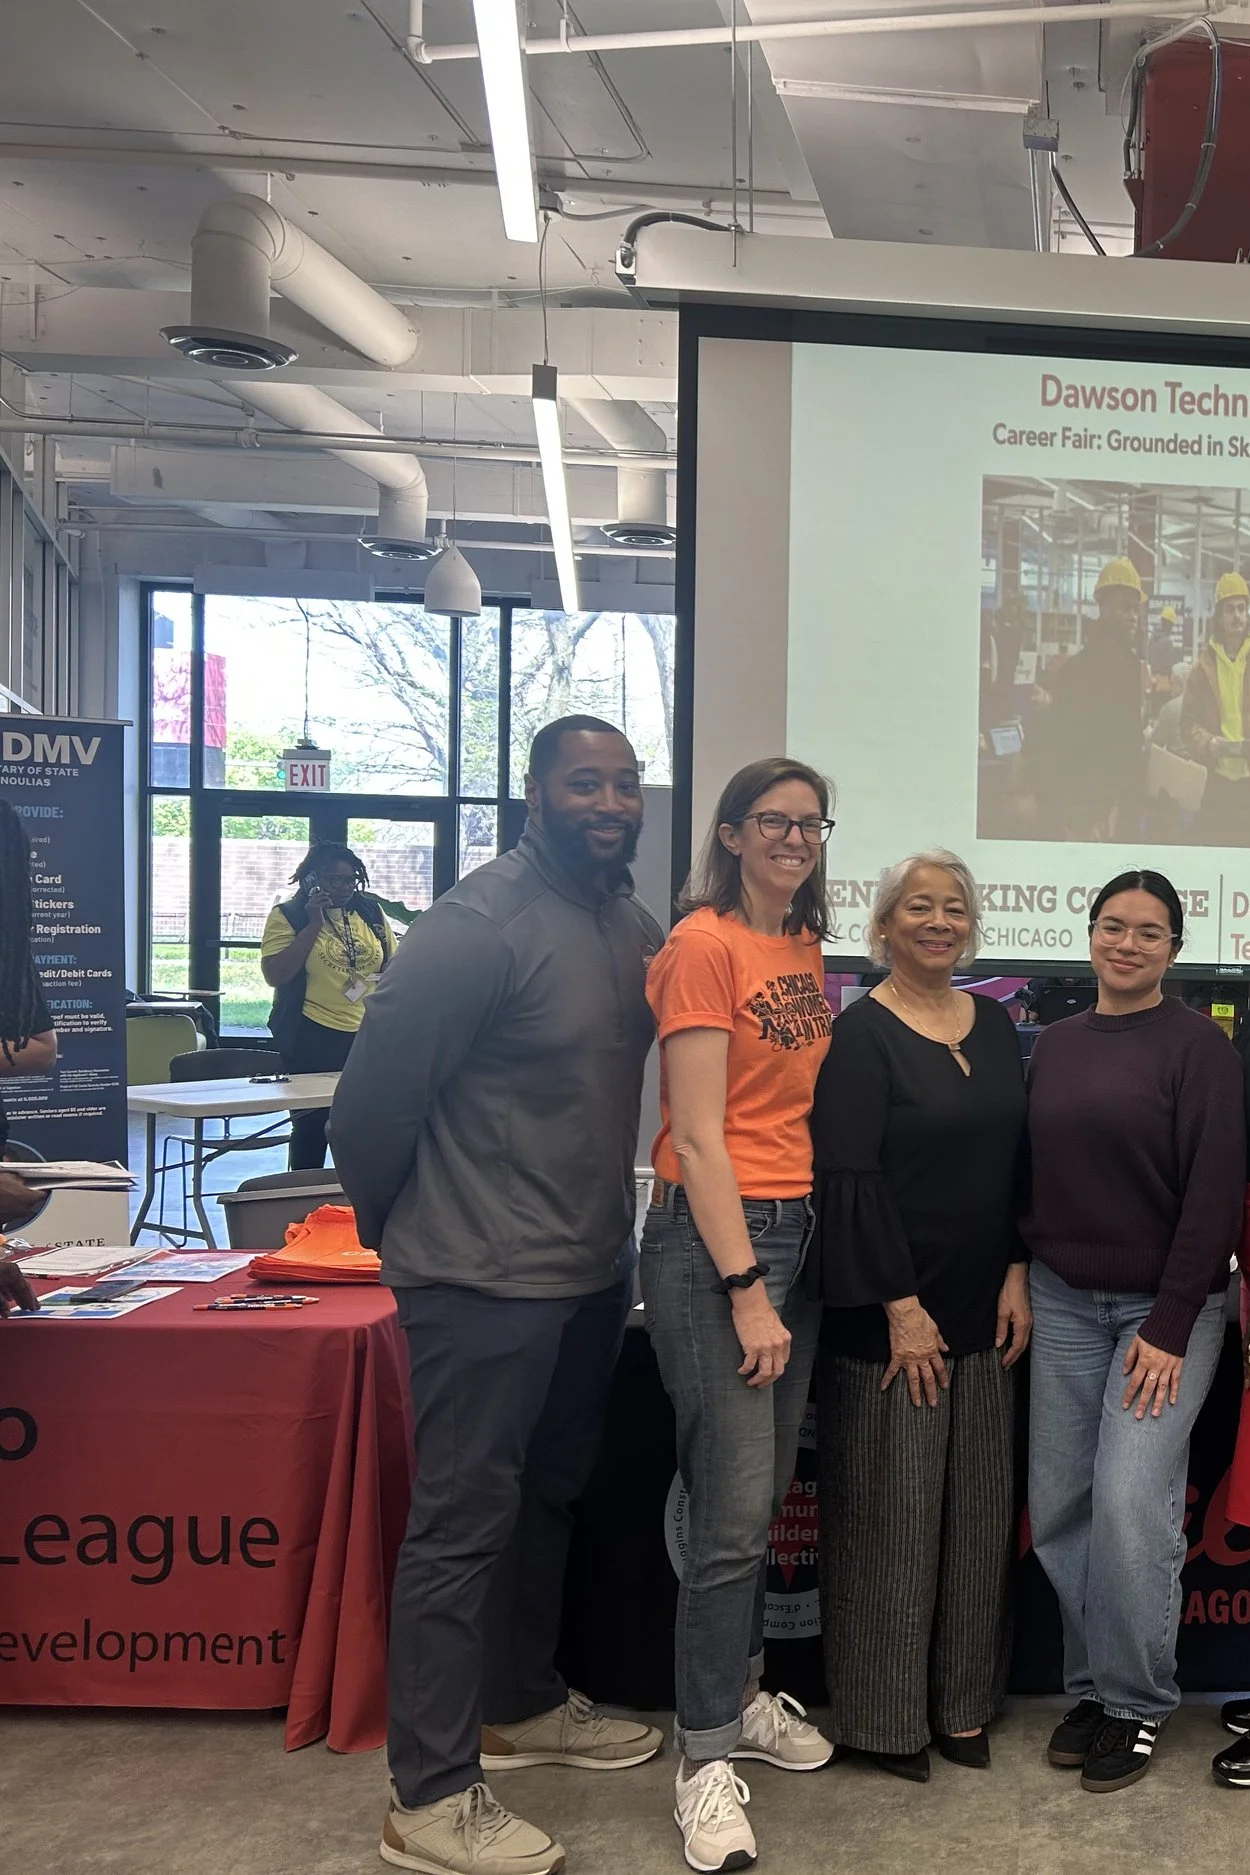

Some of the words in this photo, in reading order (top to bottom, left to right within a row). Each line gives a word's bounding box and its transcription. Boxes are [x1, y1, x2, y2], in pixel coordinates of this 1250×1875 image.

[1041, 374, 1157, 412] Dawson
[993, 422, 1058, 449] Career
[1061, 426, 1102, 450] Fair:
[1106, 429, 1202, 457] Grounded
[1207, 433, 1224, 456] in
[2, 731, 102, 766] DMV
[27, 766, 43, 776] OF
[45, 767, 80, 777] STATE
[290, 763, 326, 787] EXIT
[35, 874, 62, 884] Card
[32, 899, 75, 909] tickers
[36, 924, 101, 936] Registration
[984, 926, 1073, 948] CHICAGO
[33, 954, 77, 965] AYMENT:
[87, 969, 112, 978] Cards
[777, 972, 821, 997] CHICAGO
[47, 999, 93, 1010] ICATION:
[804, 1018, 816, 1041] IN
